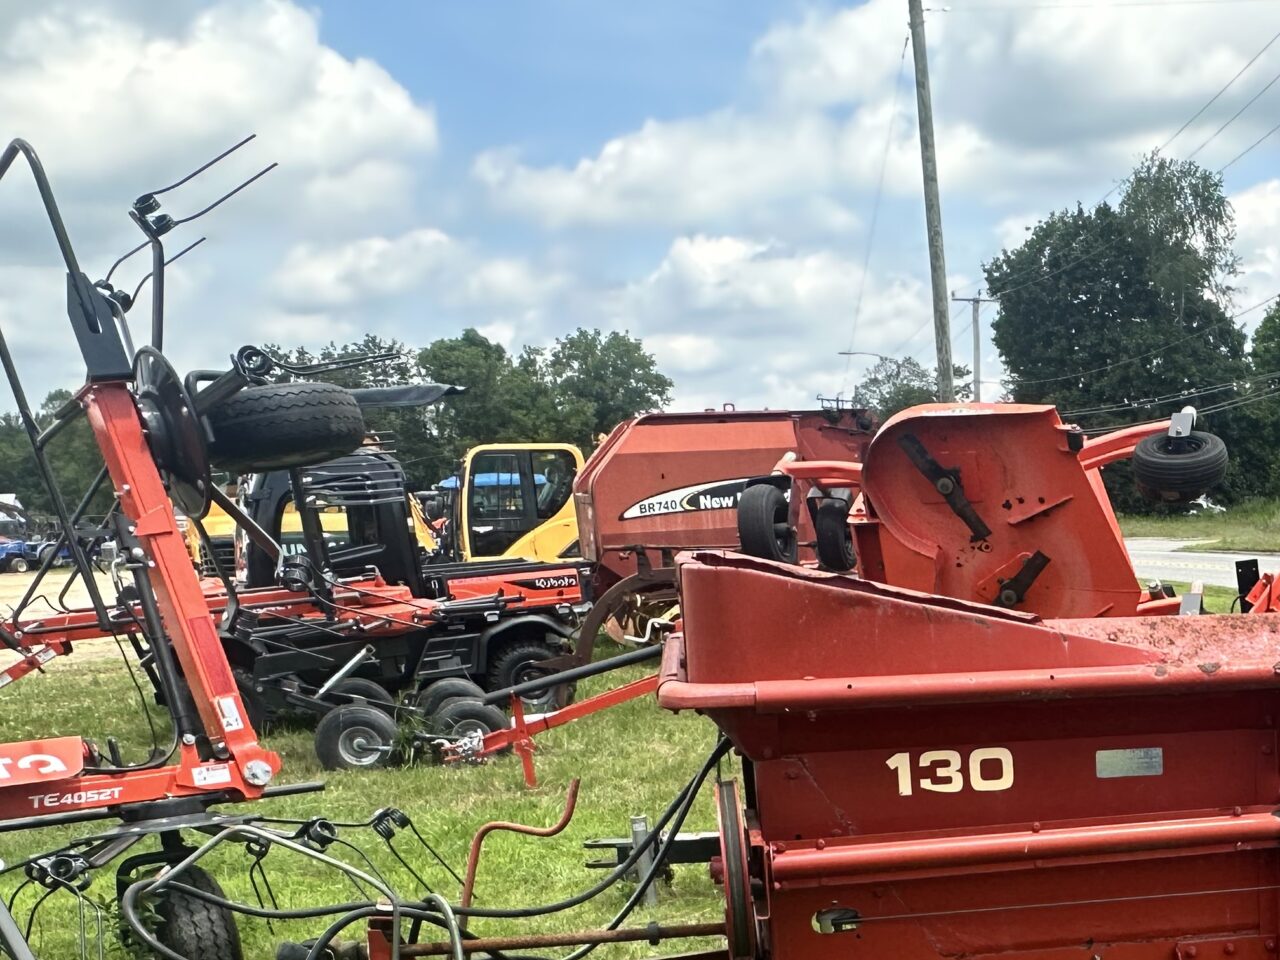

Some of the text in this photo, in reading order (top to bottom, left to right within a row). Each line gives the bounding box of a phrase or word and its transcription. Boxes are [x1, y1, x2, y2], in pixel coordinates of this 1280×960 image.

[639, 500, 677, 514] BR740
[699, 494, 734, 509] New
[535, 576, 577, 588] Kubota
[886, 747, 1014, 796] 130
[28, 786, 123, 809] TE4052T
